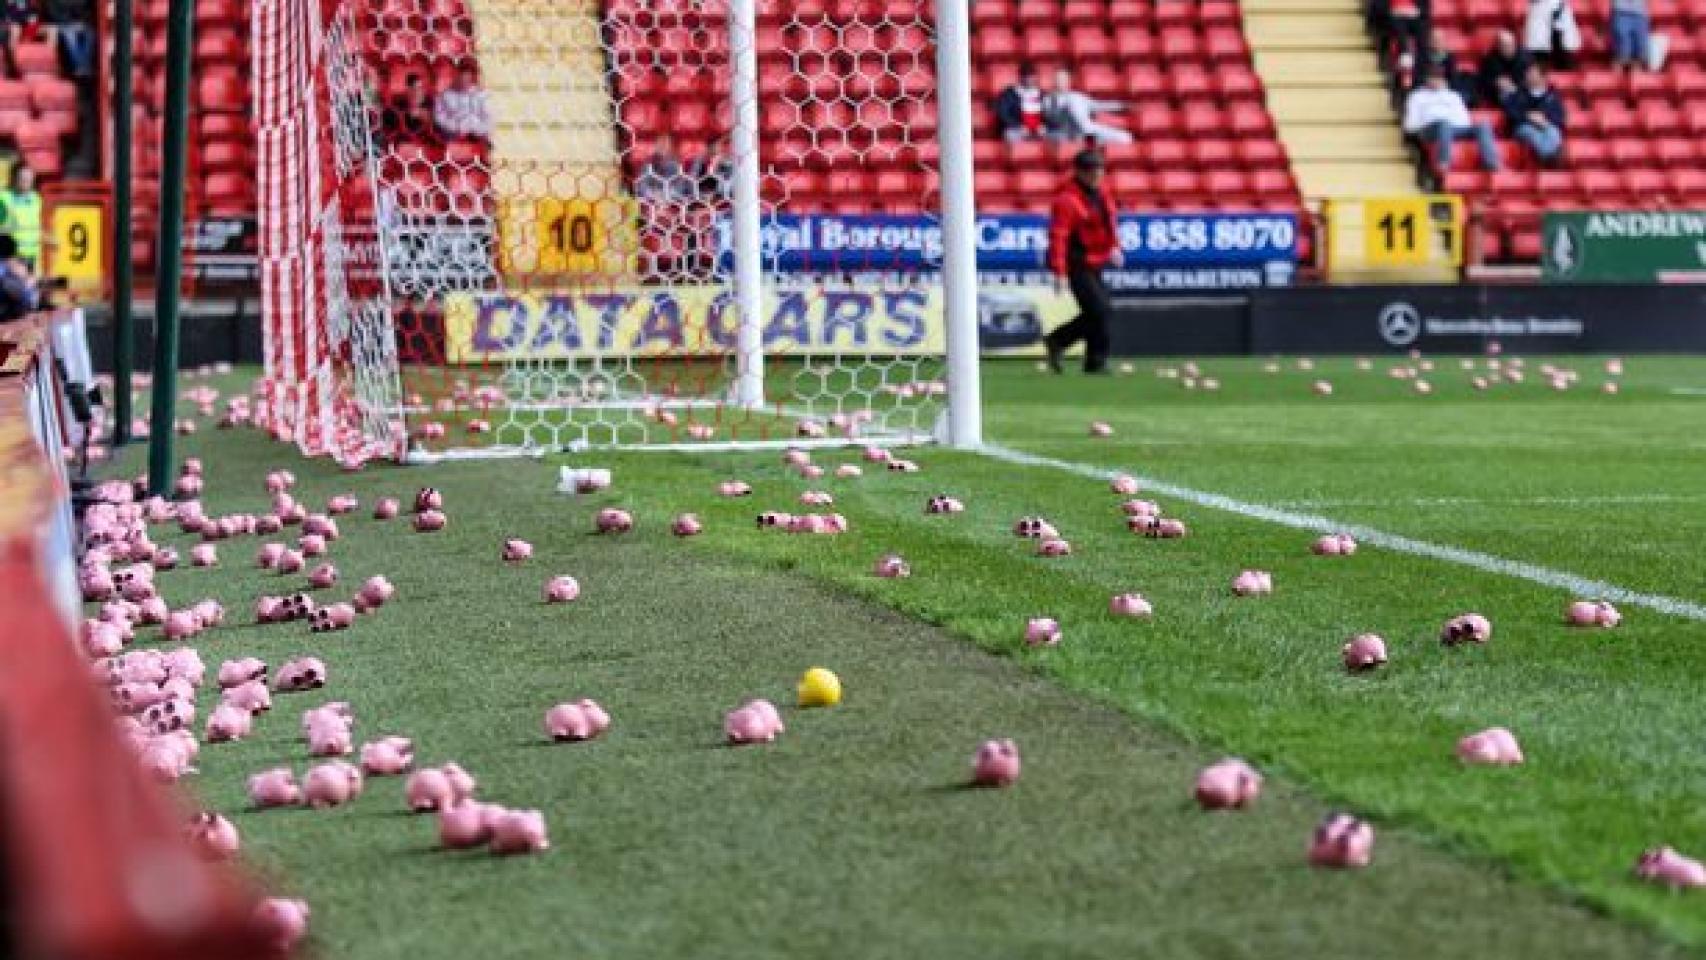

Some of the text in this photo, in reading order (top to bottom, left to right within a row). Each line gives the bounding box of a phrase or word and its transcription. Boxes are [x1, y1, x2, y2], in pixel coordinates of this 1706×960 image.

[68, 223, 88, 262] 9
[548, 214, 592, 252] 10
[821, 218, 943, 259] Boroug
[1146, 219, 1207, 250] 858
[1213, 218, 1293, 249] 8070
[1378, 213, 1415, 251] 11
[471, 293, 686, 351] DATA
